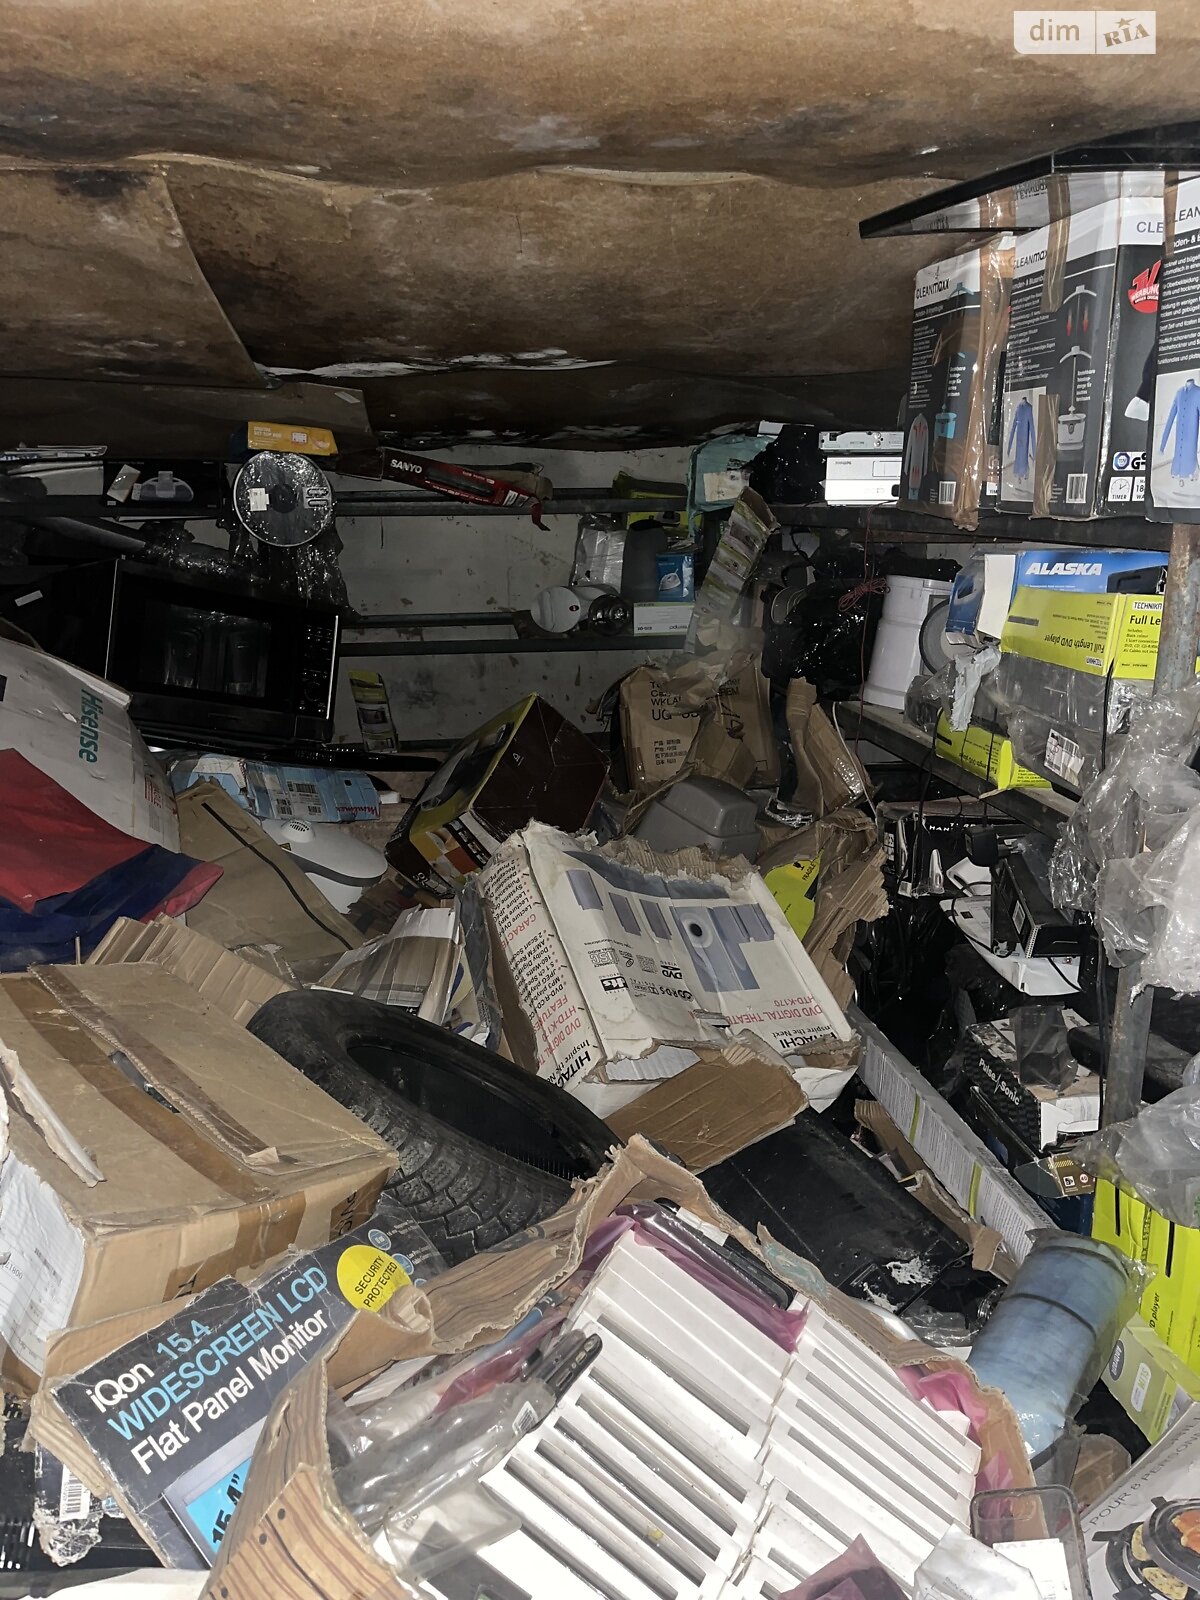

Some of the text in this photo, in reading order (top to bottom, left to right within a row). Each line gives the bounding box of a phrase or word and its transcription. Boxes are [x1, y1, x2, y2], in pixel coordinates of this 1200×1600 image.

[390, 458, 423, 474] SANYO
[1025, 563, 1102, 576] ALASKA
[1129, 615, 1148, 625] Full
[1044, 633, 1061, 647] player
[1060, 637, 1074, 648] DVD
[1073, 639, 1094, 651] Length
[78, 688, 104, 764] Hisense
[801, 861, 817, 881] FRAGILE
[512, 904, 533, 923] Lecture
[524, 936, 539, 950] Scart
[532, 946, 549, 960] Dolby
[547, 976, 561, 989] MP3
[662, 970, 683, 980] DVD
[546, 983, 564, 1000] DVD-R
[773, 994, 816, 1007] HTD-K170
[763, 1008, 801, 1021] DIGITAL
[803, 1004, 823, 1017] DVD
[565, 1017, 582, 1036] DVD
[771, 1029, 794, 1039] Next
[564, 1039, 590, 1063] Inspire
[978, 1057, 1020, 1106] Pulse Sonic
[354, 1255, 385, 1295] SECURITY
[363, 1261, 398, 1308] PROTECTED
[1151, 1292, 1161, 1321] player
[107, 1266, 329, 1442] WIDESCREEN LCD
[86, 1319, 213, 1414] iQon 15.4
[130, 1309, 329, 1476] Flat Panel Monitor
[1089, 1492, 1132, 1526] POUR
[1130, 1482, 1141, 1491] 8
